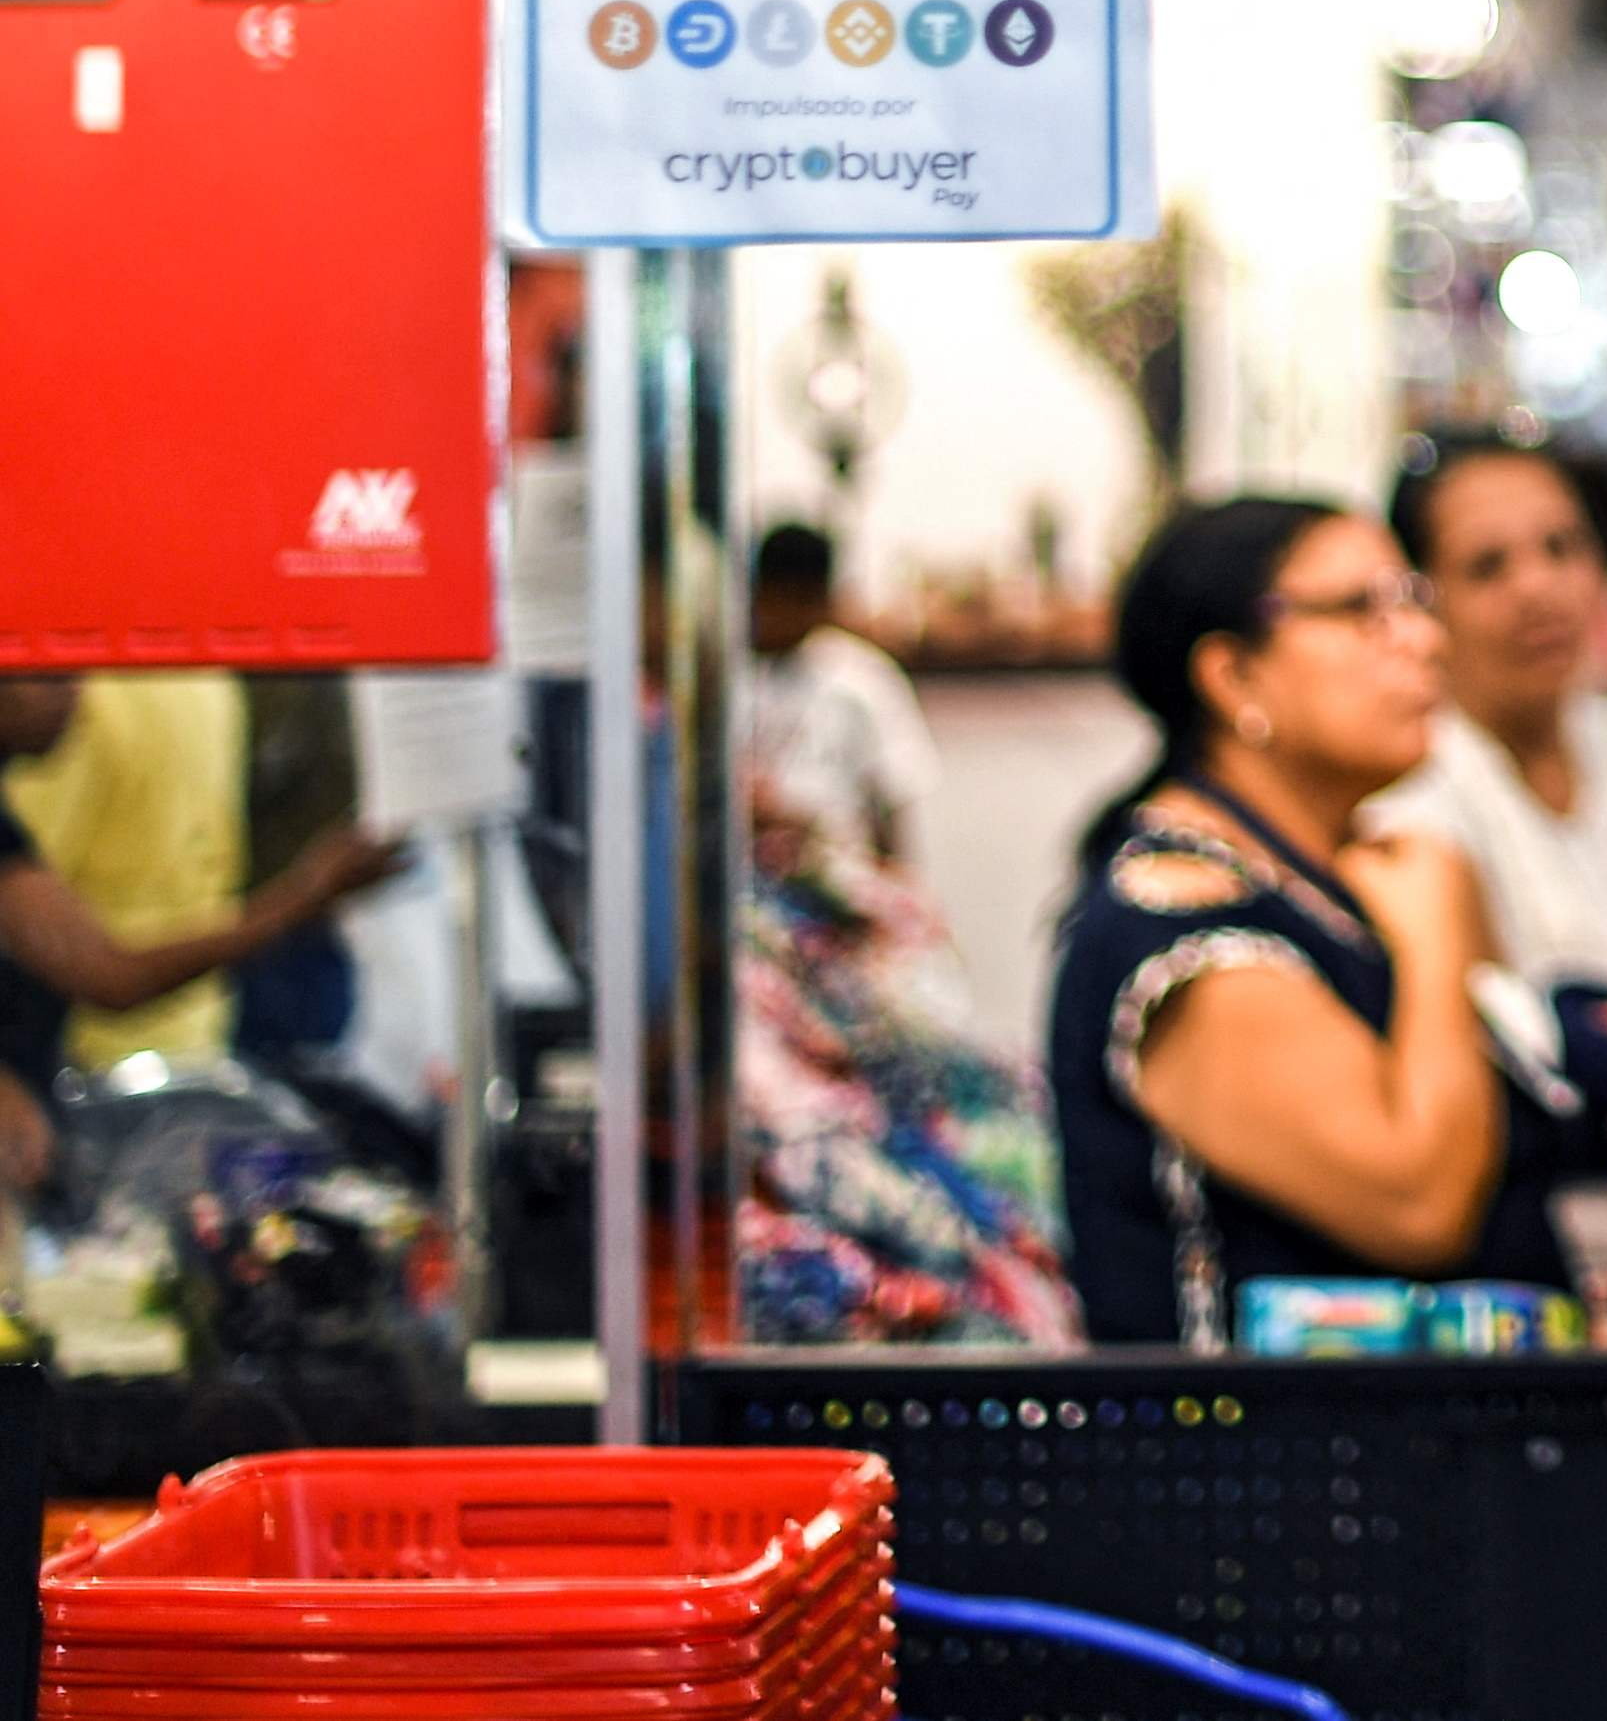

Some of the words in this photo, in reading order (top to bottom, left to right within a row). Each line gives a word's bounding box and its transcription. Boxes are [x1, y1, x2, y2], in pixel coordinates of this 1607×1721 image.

[723, 95, 866, 120] Impulsado
[871, 98, 917, 120] por
[932, 187, 980, 211] Pay
